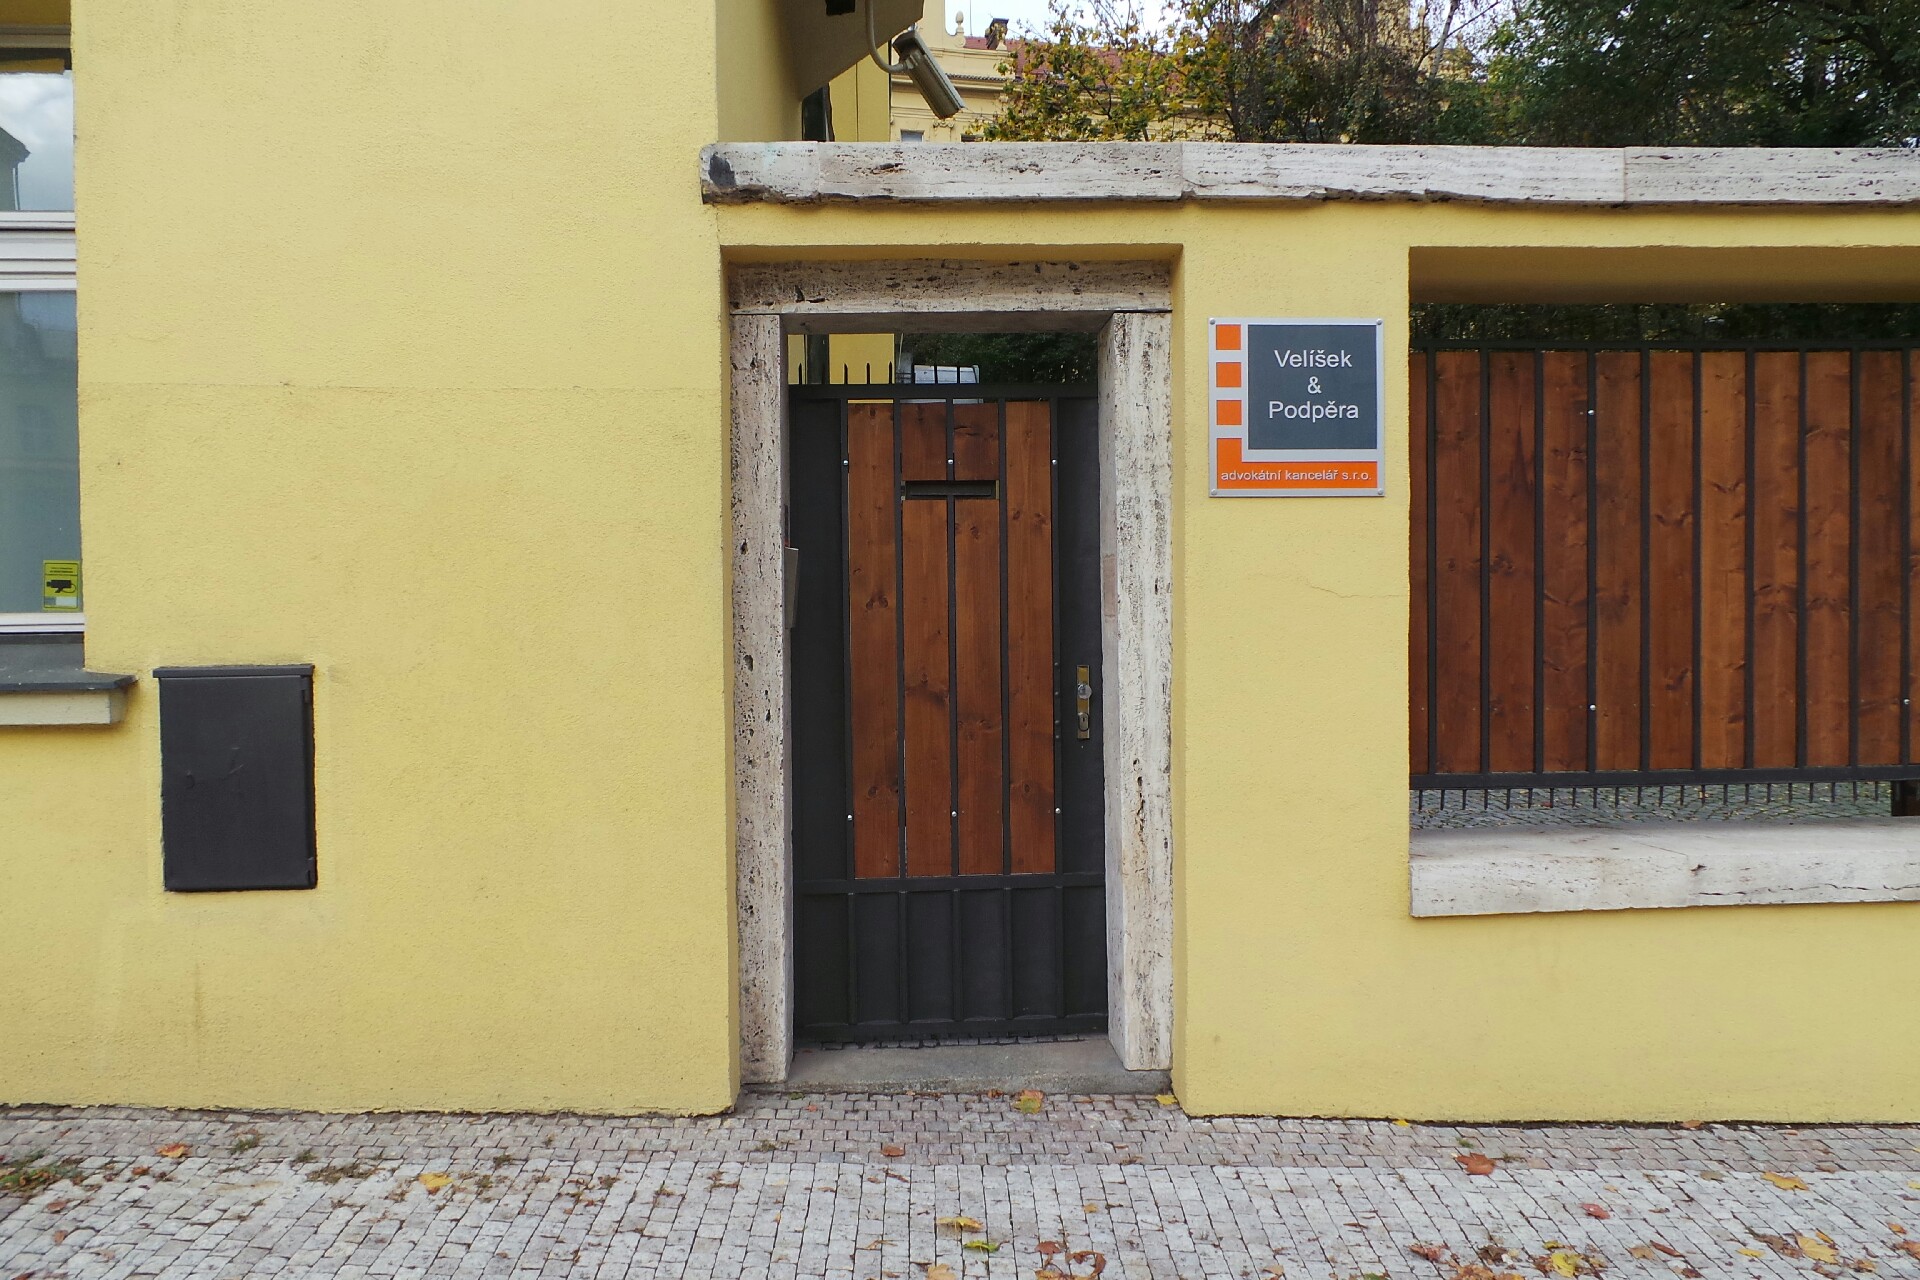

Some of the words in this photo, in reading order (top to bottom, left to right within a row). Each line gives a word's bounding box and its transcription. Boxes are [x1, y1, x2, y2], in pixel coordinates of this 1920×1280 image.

[1274, 349, 1353, 368] Velíšek
[1307, 376, 1322, 394] &
[1268, 401, 1359, 423] Podpěra
[1220, 470, 1282, 481] advokátní
[1285, 470, 1339, 480] kancelář
[1341, 471, 1372, 480] s.r.o.
